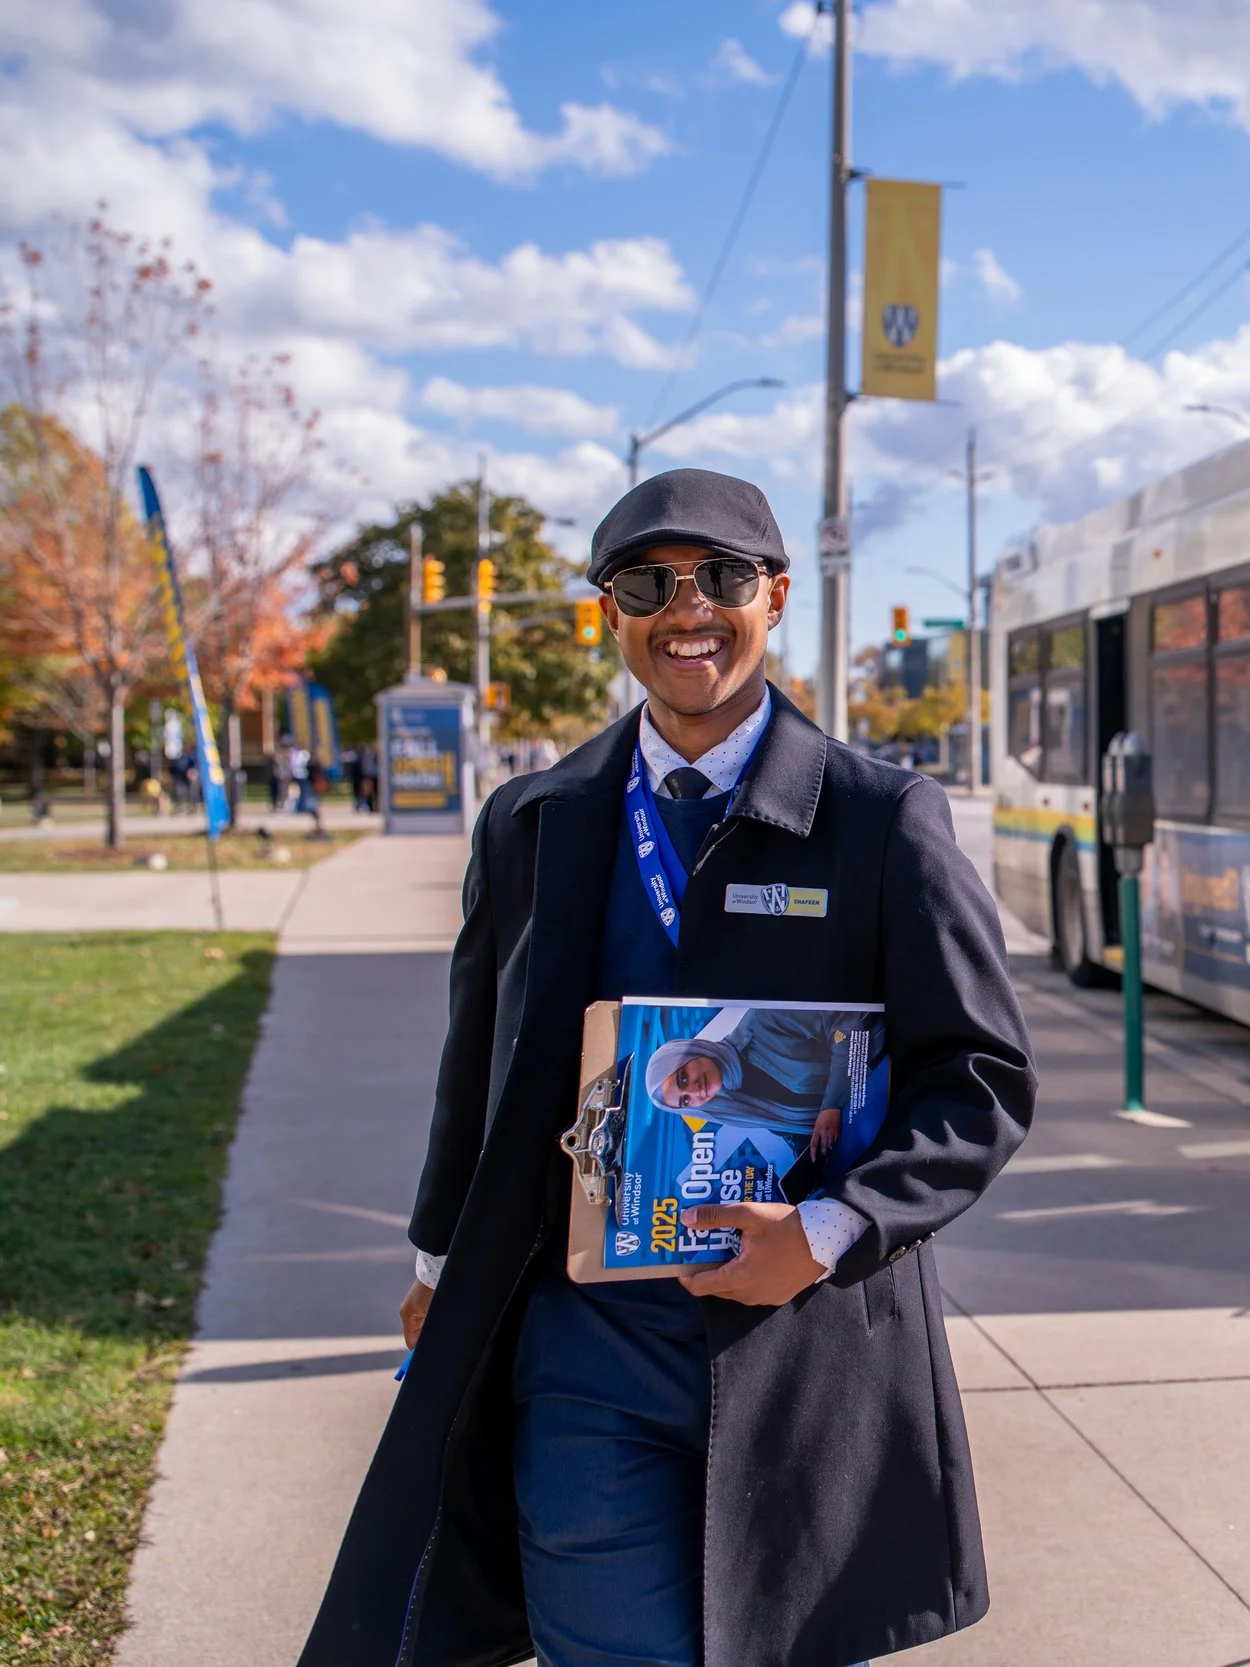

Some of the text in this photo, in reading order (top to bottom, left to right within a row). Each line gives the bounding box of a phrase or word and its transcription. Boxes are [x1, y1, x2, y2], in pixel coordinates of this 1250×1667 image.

[681, 1132, 720, 1199] Open
[745, 1166, 755, 1180] DAY
[764, 1164, 774, 1193] UWindsor
[630, 1172, 643, 1218] Windsor
[744, 1180, 754, 1195] THE
[756, 1179, 765, 1191] get
[651, 1198, 679, 1253] 2025
